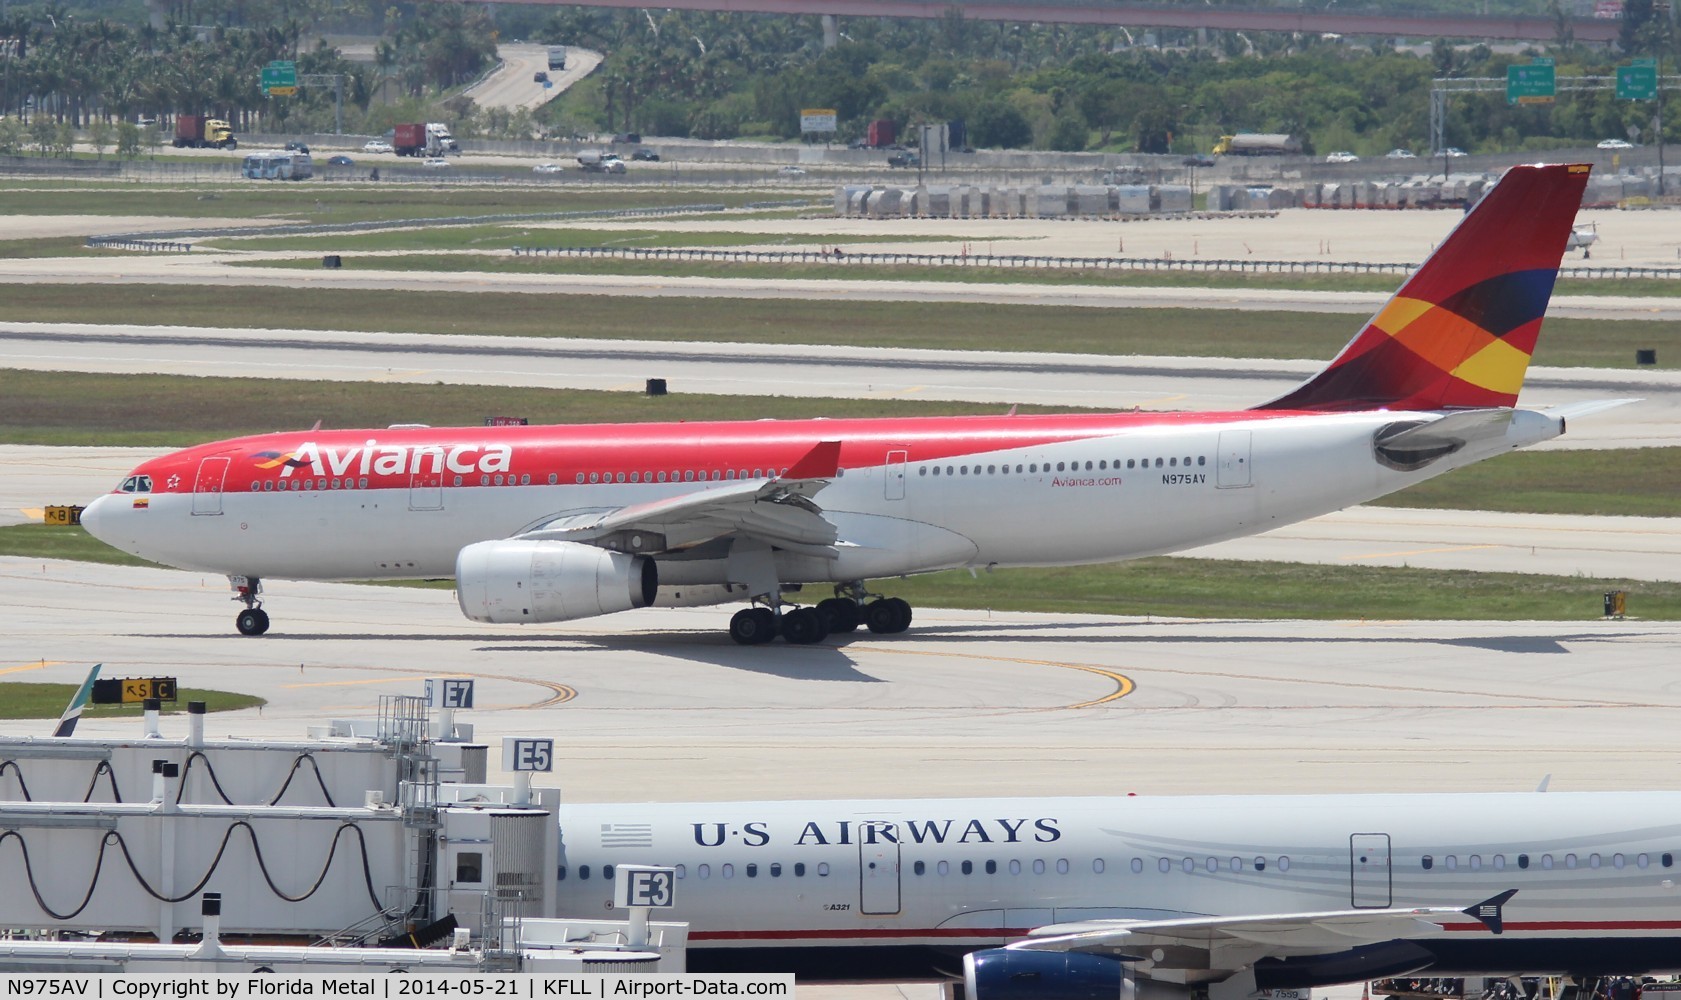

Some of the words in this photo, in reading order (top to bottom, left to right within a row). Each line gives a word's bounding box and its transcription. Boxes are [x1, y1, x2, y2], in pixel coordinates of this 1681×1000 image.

[280, 439, 513, 477] Avianca
[1051, 476, 1122, 488] Avianca.com
[1162, 474, 1206, 485] N975AV
[58, 509, 66, 521] B
[138, 684, 147, 697] S
[158, 683, 168, 697] C
[445, 681, 470, 707] E7
[517, 741, 549, 771] E5
[795, 817, 1061, 846] AIRWAYS
[632, 872, 669, 906] E3
[829, 903, 851, 911] A321
[1275, 989, 1299, 999] 7559
